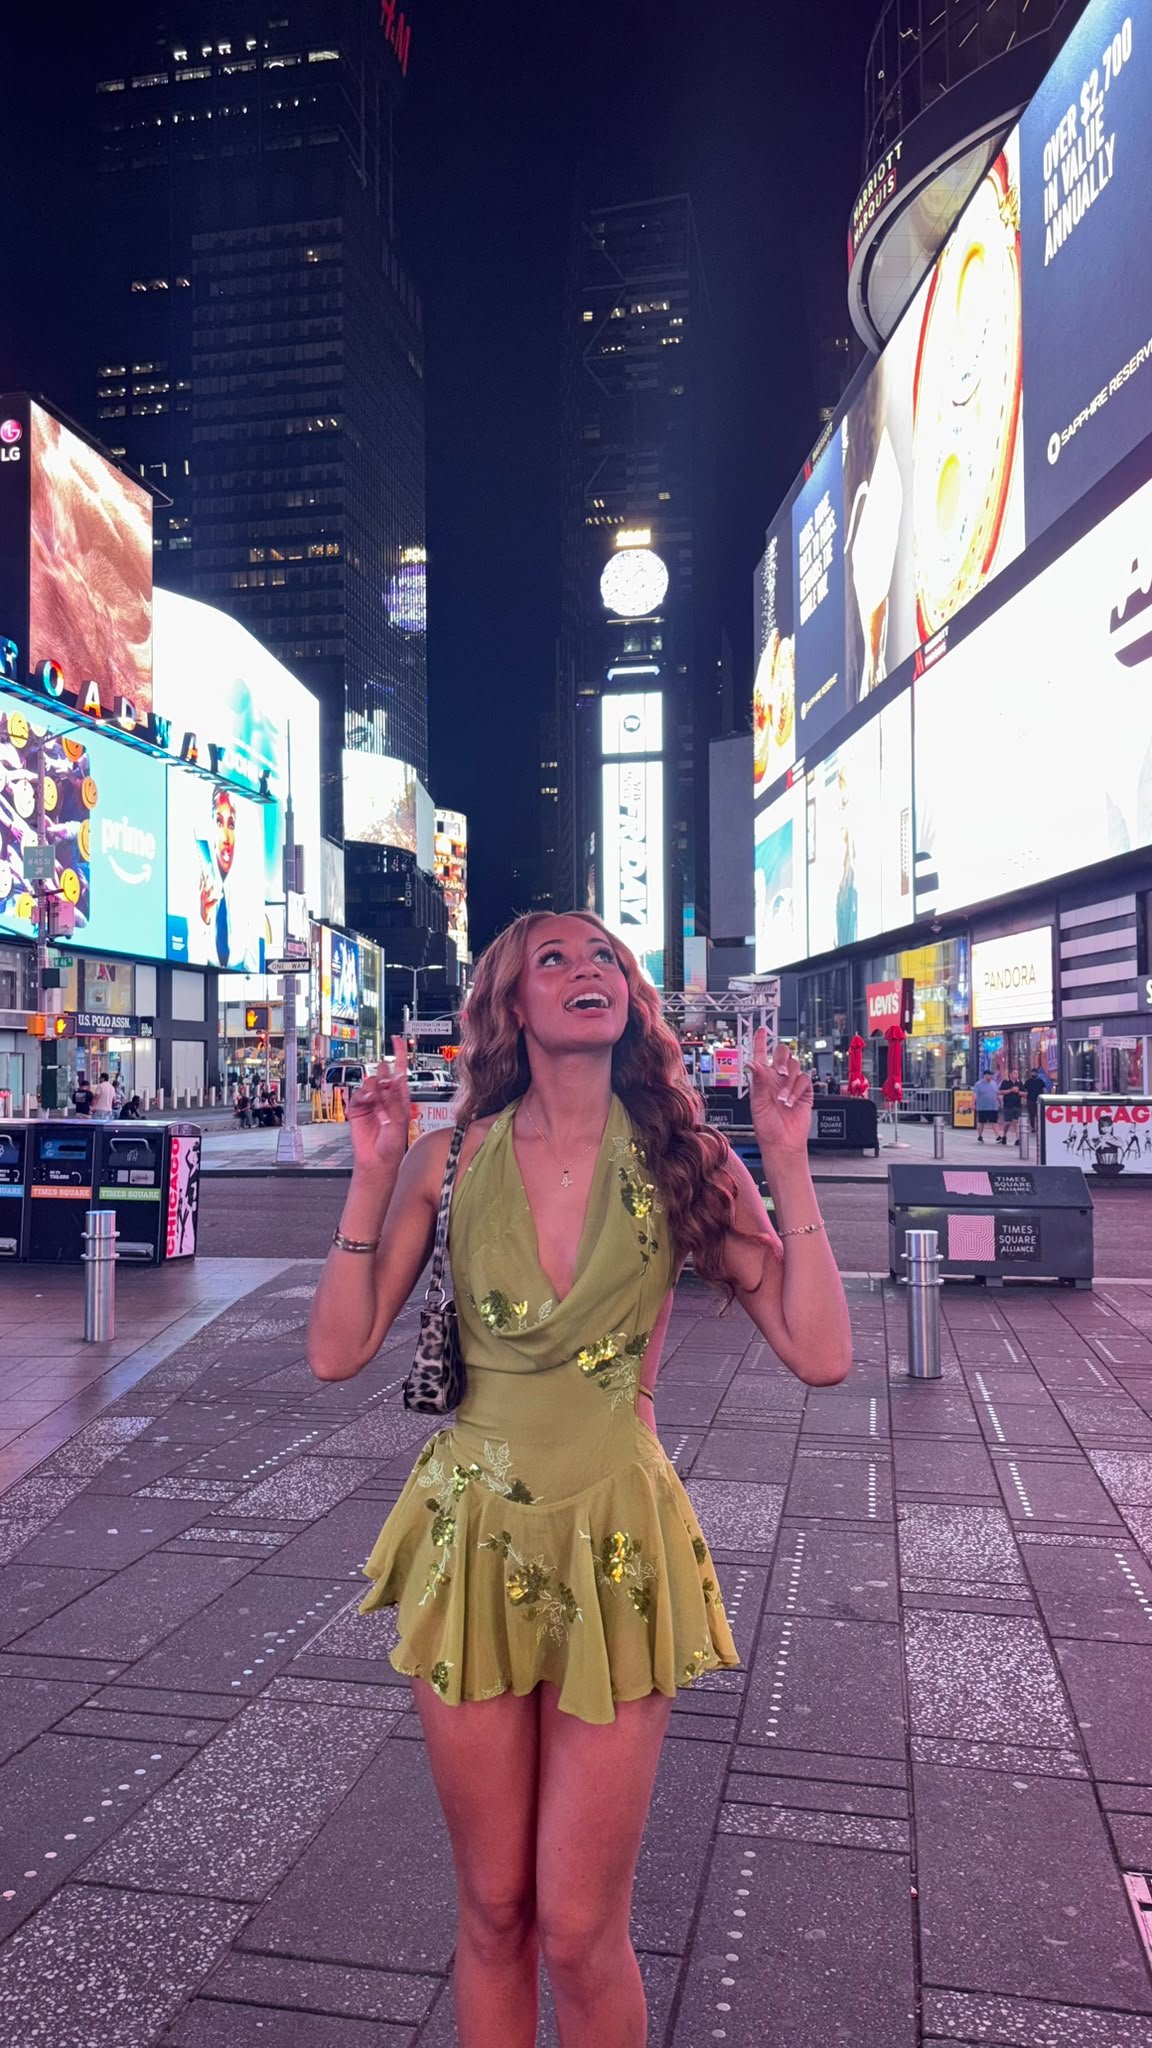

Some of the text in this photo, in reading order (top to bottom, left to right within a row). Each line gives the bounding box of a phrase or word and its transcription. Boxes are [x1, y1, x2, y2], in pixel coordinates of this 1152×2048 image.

[1043, 17, 1132, 181] OVER $2,700
[1043, 104, 1104, 225] IN VALUE
[853, 141, 902, 226] MARRIOTT
[1044, 132, 1115, 267] ANNUALLY
[854, 175, 894, 249] MARQUIS
[1061, 386, 1108, 446] SAPPHIRE
[1, 446, 21, 462] LG
[101, 815, 156, 860] prime
[984, 963, 1037, 991] PANDORA
[78, 1014, 131, 1029] U.S. POLO ASSN.
[427, 1106, 448, 1120] FIND
[33, 1188, 90, 1197] TIMES SQUARE
[128, 1190, 159, 1199] SQUARE
[167, 1138, 180, 1257] CHICAGO
[999, 1235, 1037, 1245] SQUARE
[1002, 1225, 1033, 1234] TIMES
